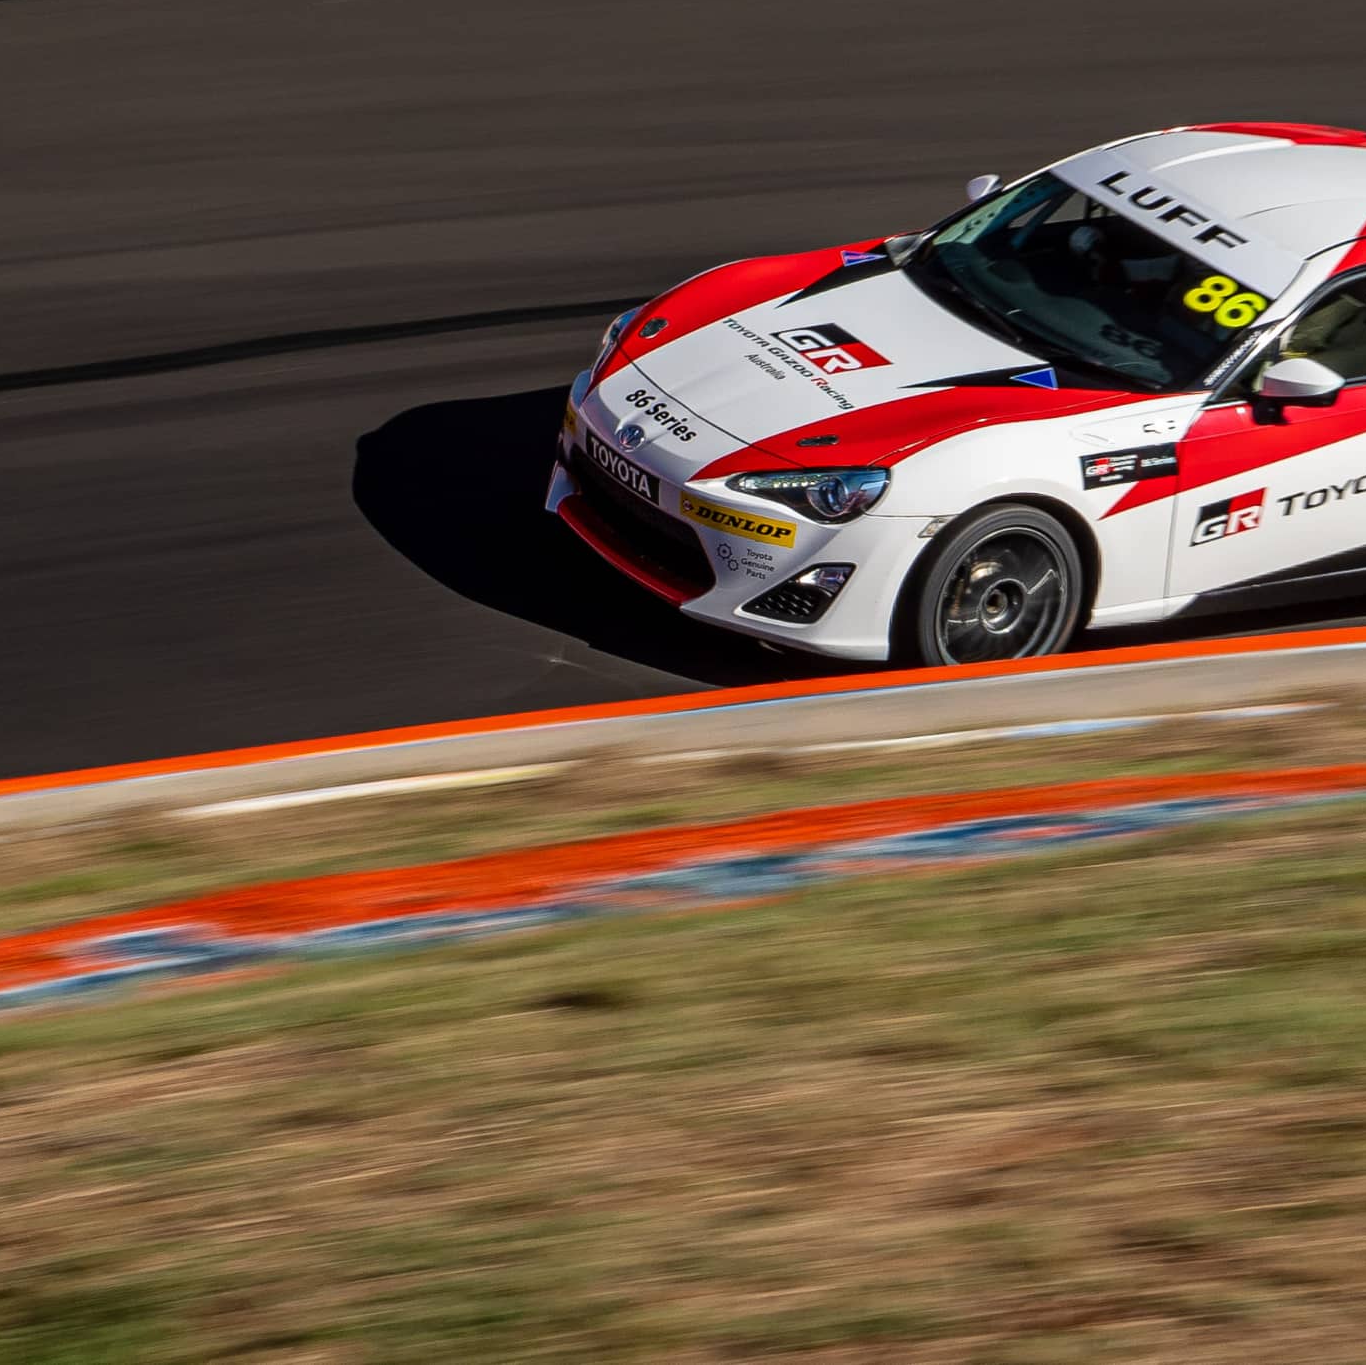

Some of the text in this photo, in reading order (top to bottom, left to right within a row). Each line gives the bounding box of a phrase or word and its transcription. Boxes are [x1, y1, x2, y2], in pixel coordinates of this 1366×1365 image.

[1096, 170, 1250, 249] LUFF
[1183, 275, 1268, 328] 86
[722, 318, 857, 410] TOYOTA GAZOO Racing
[744, 353, 786, 381] Australia
[778, 329, 862, 374] GR
[626, 389, 697, 442] 86 Series
[591, 437, 652, 498] TOYOTA
[696, 506, 792, 539] DUNLOP
[1193, 505, 1262, 543] GR
[741, 558, 775, 572] Genuine
[746, 548, 773, 561] Toyota
[746, 568, 766, 580] Parts
